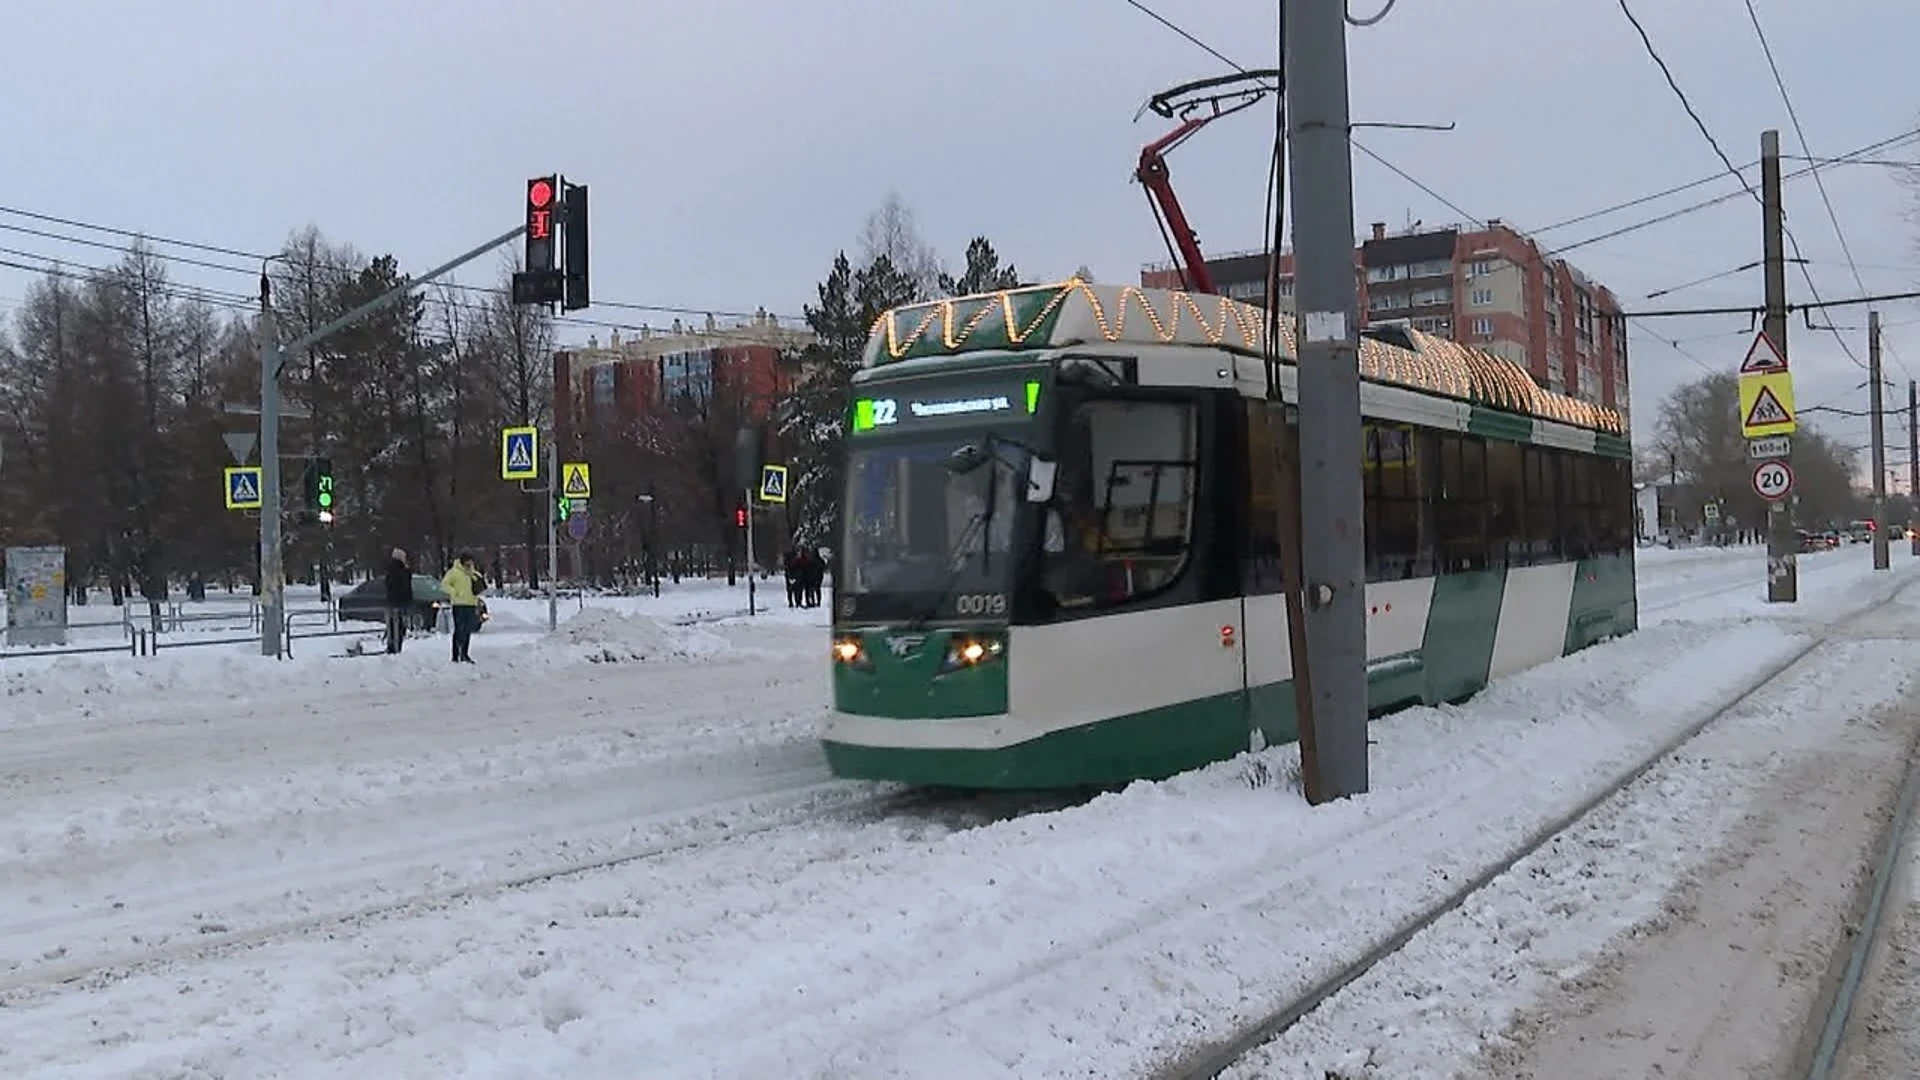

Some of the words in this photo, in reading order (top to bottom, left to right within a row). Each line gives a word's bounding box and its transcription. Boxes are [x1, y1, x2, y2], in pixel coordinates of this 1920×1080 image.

[872, 399, 897, 425] 22
[1761, 471, 1784, 488] 20
[956, 594, 1006, 614] 0019
